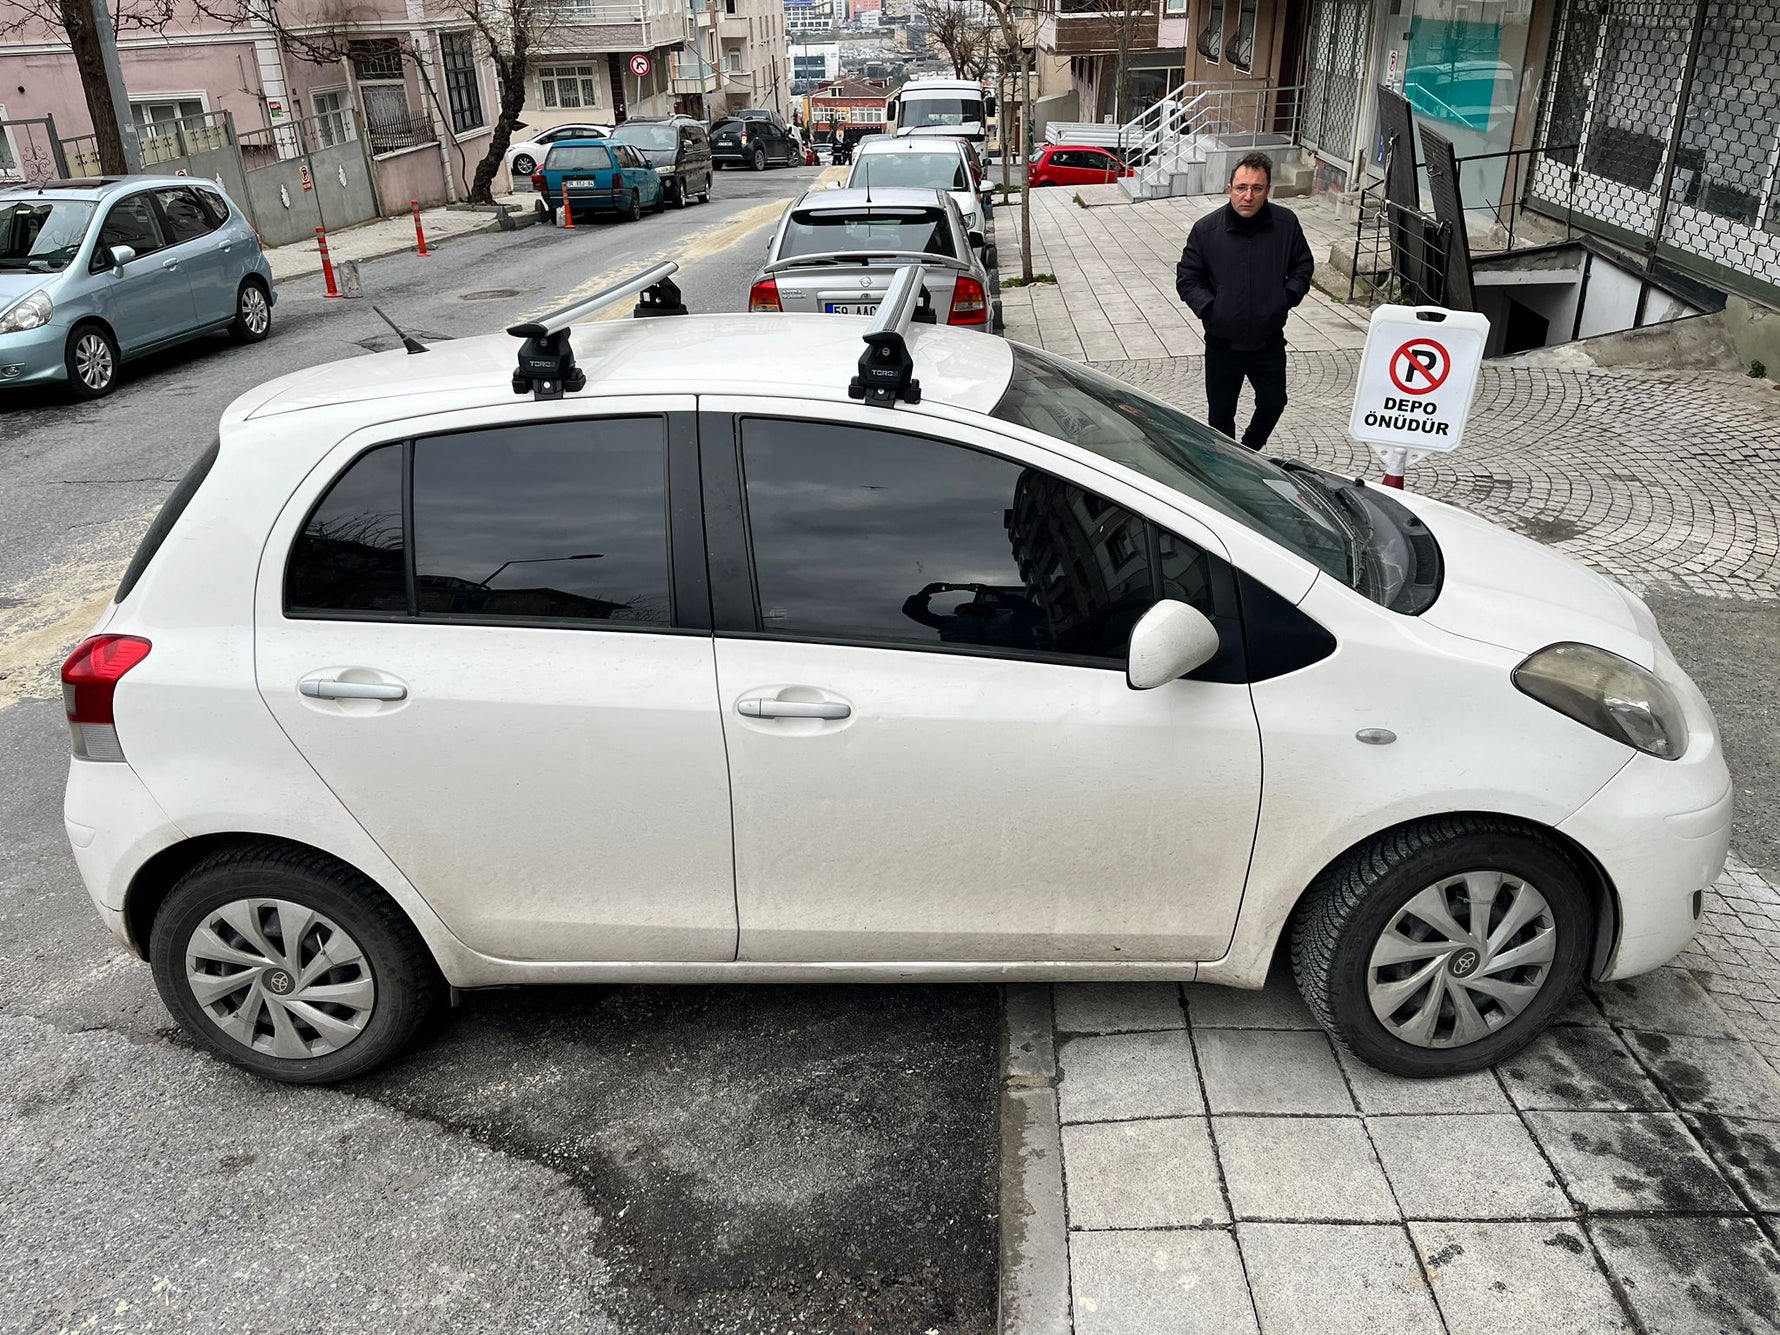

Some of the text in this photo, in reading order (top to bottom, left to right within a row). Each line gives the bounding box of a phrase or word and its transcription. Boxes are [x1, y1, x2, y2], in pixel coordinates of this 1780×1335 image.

[834, 306, 848, 314] 59
[1384, 397, 1437, 415] DEPO
[1364, 411, 1449, 436] ÖNÜDÜR
